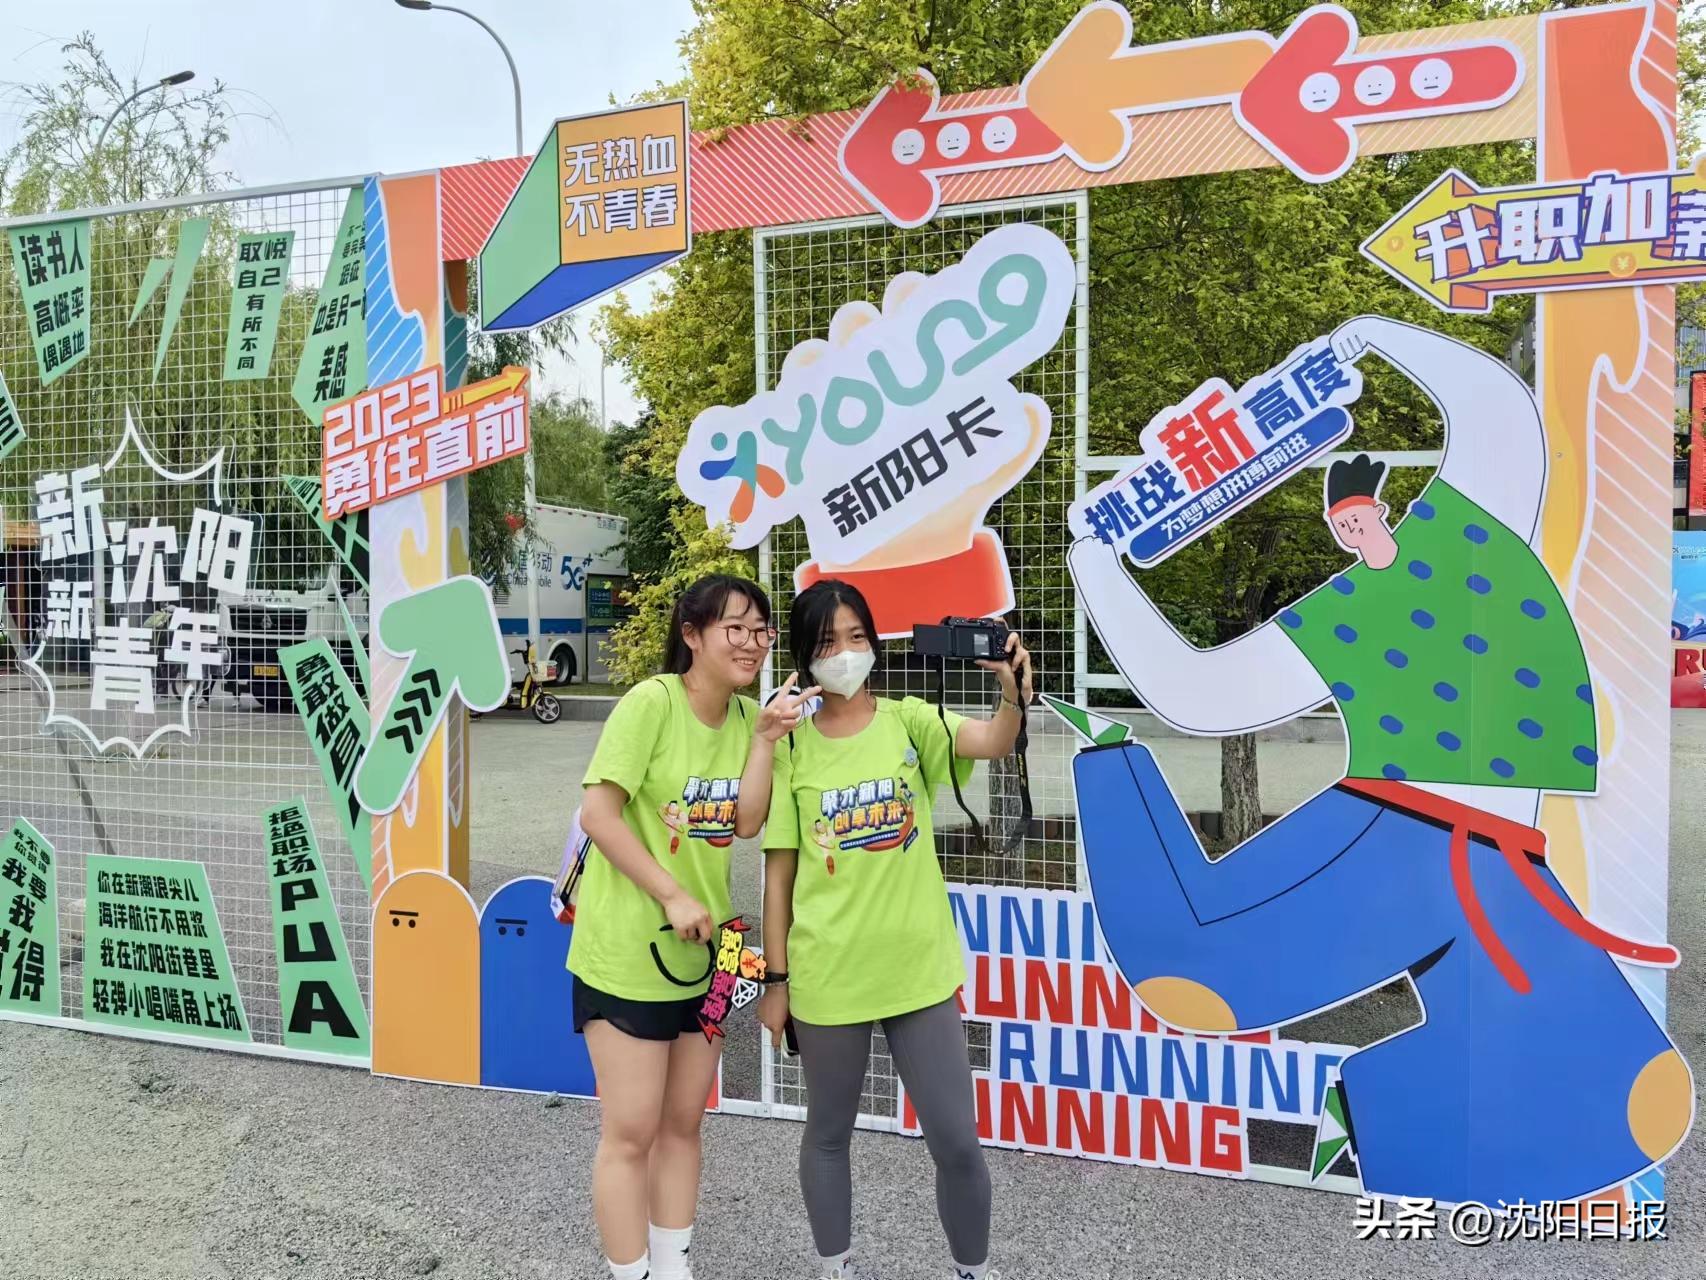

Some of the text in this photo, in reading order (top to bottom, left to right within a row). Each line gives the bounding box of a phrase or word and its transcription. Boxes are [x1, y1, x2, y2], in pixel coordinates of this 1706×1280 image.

[564, 134, 678, 187] 无热血
[564, 184, 678, 236] 不青春
[18, 226, 85, 287] 读书人
[239, 237, 287, 263] 取悦
[237, 266, 281, 289] 自己
[33, 286, 85, 338] 高概率
[43, 329, 86, 374] 偶遇地
[312, 341, 349, 403] 美感
[325, 369, 440, 460] 2023
[325, 394, 525, 517] 勇往直前
[822, 395, 1004, 538] 新阳卡
[1084, 347, 1351, 545] 挑战新高度
[1160, 432, 1312, 541] 为梦想拼搏前进
[34, 463, 255, 603] 新沈阳
[46, 578, 225, 714] 新青年
[687, 800, 737, 827] 创享未
[821, 777, 895, 821] 聚才新阳
[833, 799, 906, 835] 创享未来
[2, 857, 48, 904] 我要
[97, 870, 200, 902] 你在新潮浪尖儿
[9, 894, 36, 934] 我
[100, 937, 220, 980] 我在沈阳街巷里
[92, 977, 243, 1031] 轻弹小唱嘴角上扬
